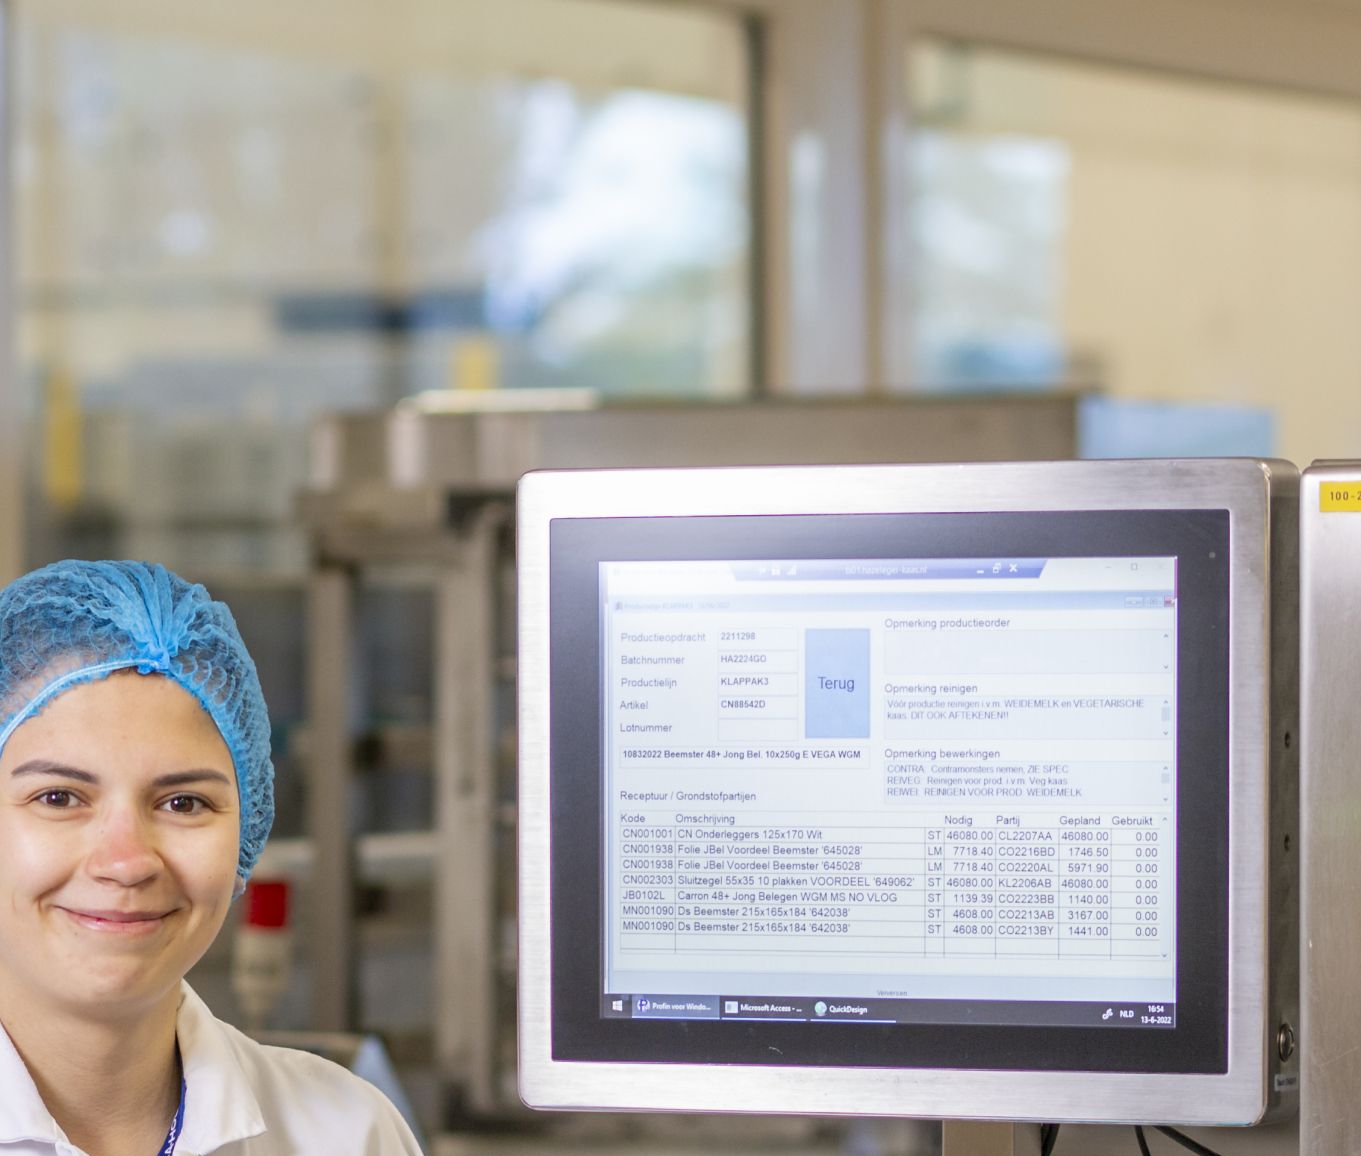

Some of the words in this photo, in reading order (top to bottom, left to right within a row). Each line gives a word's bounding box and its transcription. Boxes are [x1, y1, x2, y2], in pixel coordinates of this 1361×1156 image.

[885, 618, 937, 630] Opmerking
[940, 618, 1010, 629] productieorder
[621, 633, 706, 643] Productieopdracht
[721, 632, 756, 641] 2211298
[621, 656, 685, 665] Batchnummer
[621, 678, 677, 689] Productielijn
[721, 677, 769, 686] KLAPPAK3
[818, 677, 855, 692] Terug
[885, 685, 937, 695] Opmerking
[940, 685, 978, 695] reinigen
[620, 701, 648, 710] Artikel
[909, 700, 945, 709] productie
[948, 700, 979, 710] reinigen
[1005, 700, 1059, 708] WEIDEMELK
[1074, 700, 1144, 708] VEGETARISCHE
[911, 711, 924, 719] DIT
[927, 711, 946, 719] OOK
[948, 711, 1009, 719] AFTEKENEN!!
[620, 724, 672, 733] Lotnummer
[623, 751, 662, 759] 10832022
[664, 751, 704, 759] Beemster
[706, 751, 721, 759] 48+
[723, 751, 744, 760] Jong
[766, 751, 800, 760] 10x250g
[803, 751, 809, 759] E
[811, 751, 836, 759] VEGA
[838, 751, 861, 759] WGM
[885, 749, 937, 760] Opmerking
[940, 749, 1000, 760] bewerkingen
[931, 765, 994, 773] Contramonsters
[1027, 765, 1040, 773] ZIE
[1043, 765, 1069, 773] SPEC
[927, 777, 962, 786] Reinigen
[621, 791, 668, 802] Receptuur
[676, 792, 756, 802] Grondstofpartijen
[925, 788, 965, 796] REINIGEN
[967, 788, 994, 796] VOOR
[1027, 788, 1082, 796] WEIDEMELK
[620, 814, 645, 823] Kode
[676, 814, 735, 825] Omschrijving
[945, 816, 973, 827] Nodig
[996, 816, 1020, 827] Partij
[1060, 816, 1101, 827] Gepland
[1112, 817, 1152, 826] Gebruikt
[623, 830, 673, 838] CN001001
[678, 830, 693, 839] CN
[696, 830, 760, 841] Onderleggers
[763, 830, 804, 839] 125x170
[806, 830, 822, 839] Wit
[928, 831, 941, 840] ST
[946, 832, 993, 840] 46080.00
[999, 832, 1052, 841] CL2207AA
[1061, 832, 1109, 841] 46080.00
[1136, 833, 1157, 841] 0.00
[623, 845, 673, 854] CN001938
[678, 846, 700, 855] Folie
[704, 846, 724, 855] JBel
[727, 846, 770, 855] Voordeel
[773, 846, 819, 855] Beemster
[928, 847, 942, 856] LM
[953, 847, 993, 856] 7718.40
[1069, 848, 1109, 857] 1746.50
[1136, 849, 1157, 857] 0.00
[623, 860, 673, 869] CN001938
[678, 861, 700, 870] Folie
[704, 861, 724, 870] JBel
[727, 862, 770, 870] Voordeel
[773, 862, 819, 871] Beemster
[928, 863, 942, 871] LM
[953, 863, 993, 872] 7718.40
[1068, 864, 1109, 872] 5971.90
[1136, 864, 1157, 873] 0.00
[623, 876, 673, 885] CN002303
[678, 876, 722, 887] Sluitzegel
[726, 877, 755, 885] 55x35
[758, 877, 769, 886] 10
[772, 877, 808, 888] plakken
[811, 878, 870, 886] VOORDEEL
[928, 878, 941, 887] ST
[946, 879, 993, 887] 46080.00
[999, 879, 1051, 888] KL2206AB
[1061, 880, 1109, 888] 46080.00
[1136, 880, 1157, 889] 0.00
[622, 892, 665, 900] JB0102L
[678, 892, 709, 900] Carron
[712, 892, 729, 901] 48+
[732, 892, 756, 903] Jong
[759, 892, 798, 903] Belegen
[801, 893, 828, 901] WGM
[831, 893, 846, 901] MS
[849, 893, 865, 902] NO
[868, 893, 897, 902] VLOG
[928, 894, 941, 903] ST
[953, 894, 993, 903] 1139.39
[1069, 895, 1109, 904] 1140.00
[1136, 896, 1157, 905] 0.00
[623, 906, 674, 915] MN001090
[678, 907, 691, 916] Ds
[694, 907, 739, 916] Beemster
[742, 908, 806, 917] 215x165x184
[928, 910, 941, 918] ST
[953, 910, 993, 919] 4608.00
[1068, 911, 1109, 920] 3167.00
[1136, 912, 1157, 921] 0.00
[623, 922, 674, 930] MN001090
[678, 922, 691, 931] Ds
[694, 922, 739, 931] Beemster
[742, 923, 806, 932] 215x165x184
[928, 925, 941, 934] ST
[953, 926, 993, 934] 4608.00
[1069, 927, 1109, 936] 1441.00
[1136, 928, 1157, 936] 0.00
[740, 1004, 769, 1012] Microsoft
[830, 1006, 868, 1015] QuickDesign
[1141, 1016, 1172, 1024] 13-6-2022
